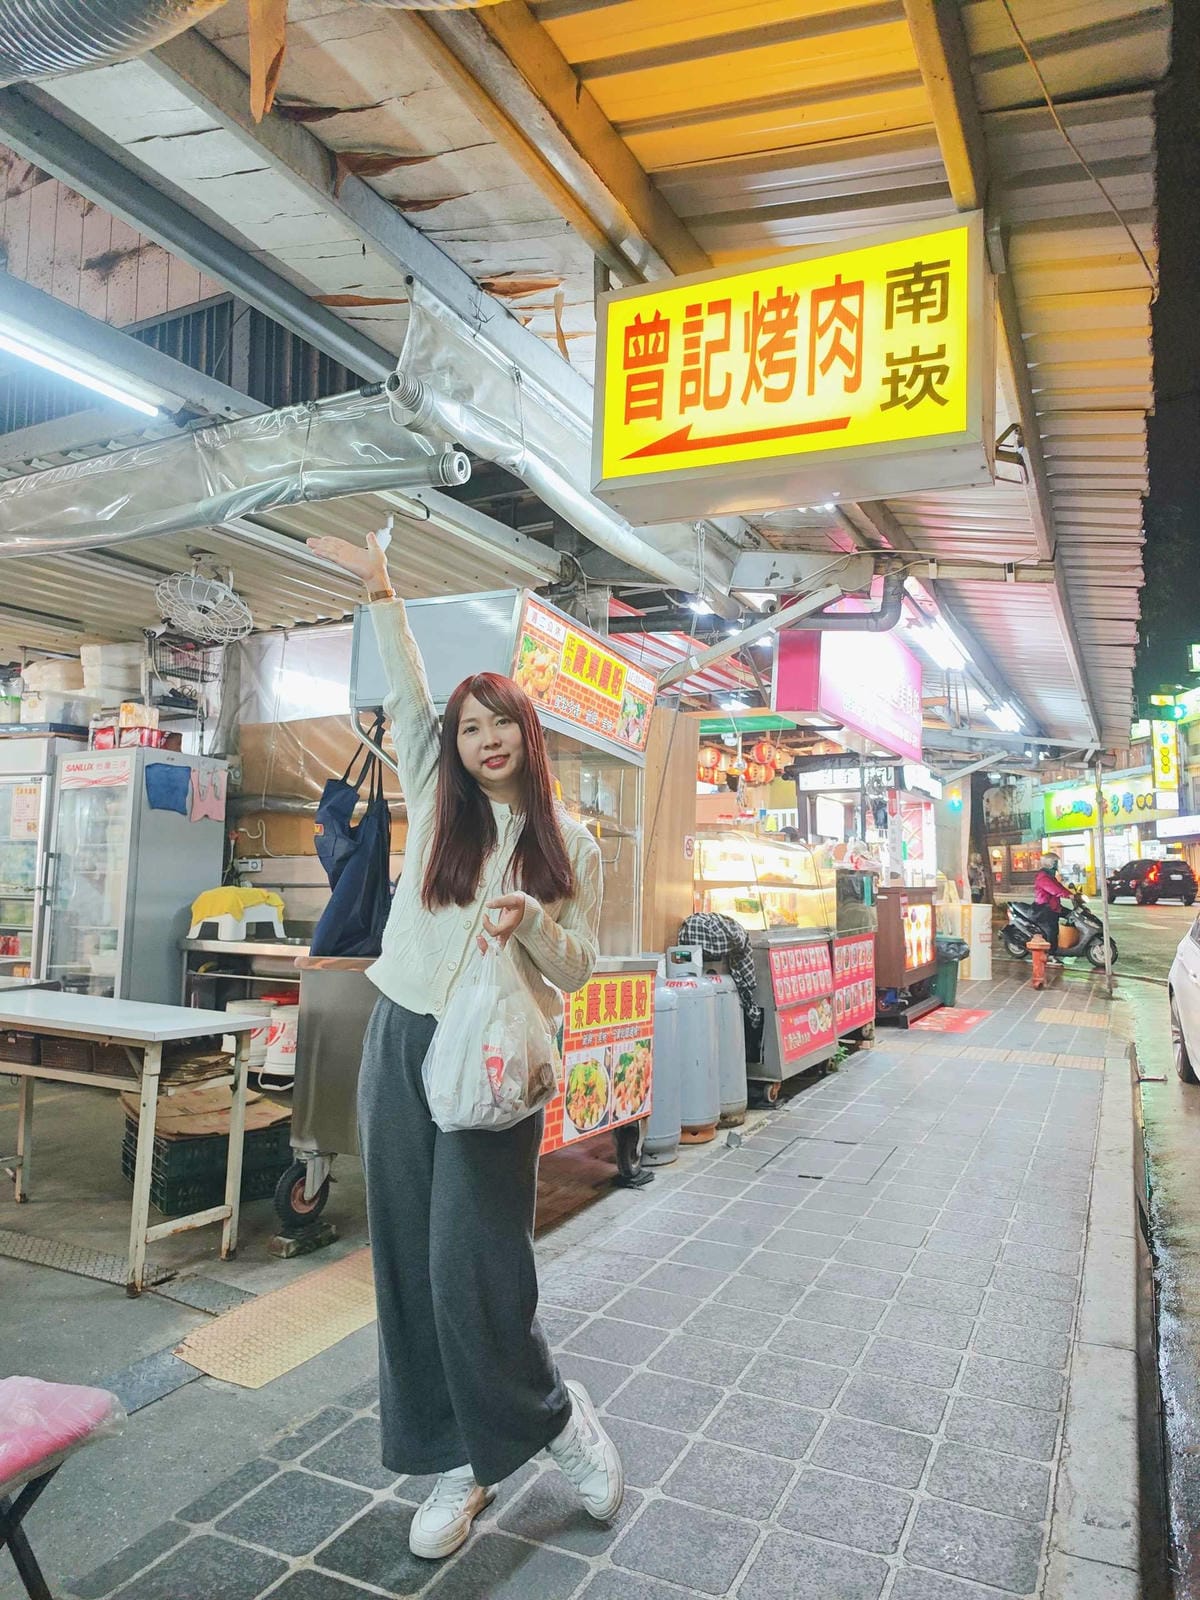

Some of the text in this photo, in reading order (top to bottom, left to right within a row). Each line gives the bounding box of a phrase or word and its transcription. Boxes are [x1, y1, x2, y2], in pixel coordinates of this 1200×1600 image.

[623, 274, 865, 425] 曾記烤肉
[880, 259, 951, 411] 南崁
